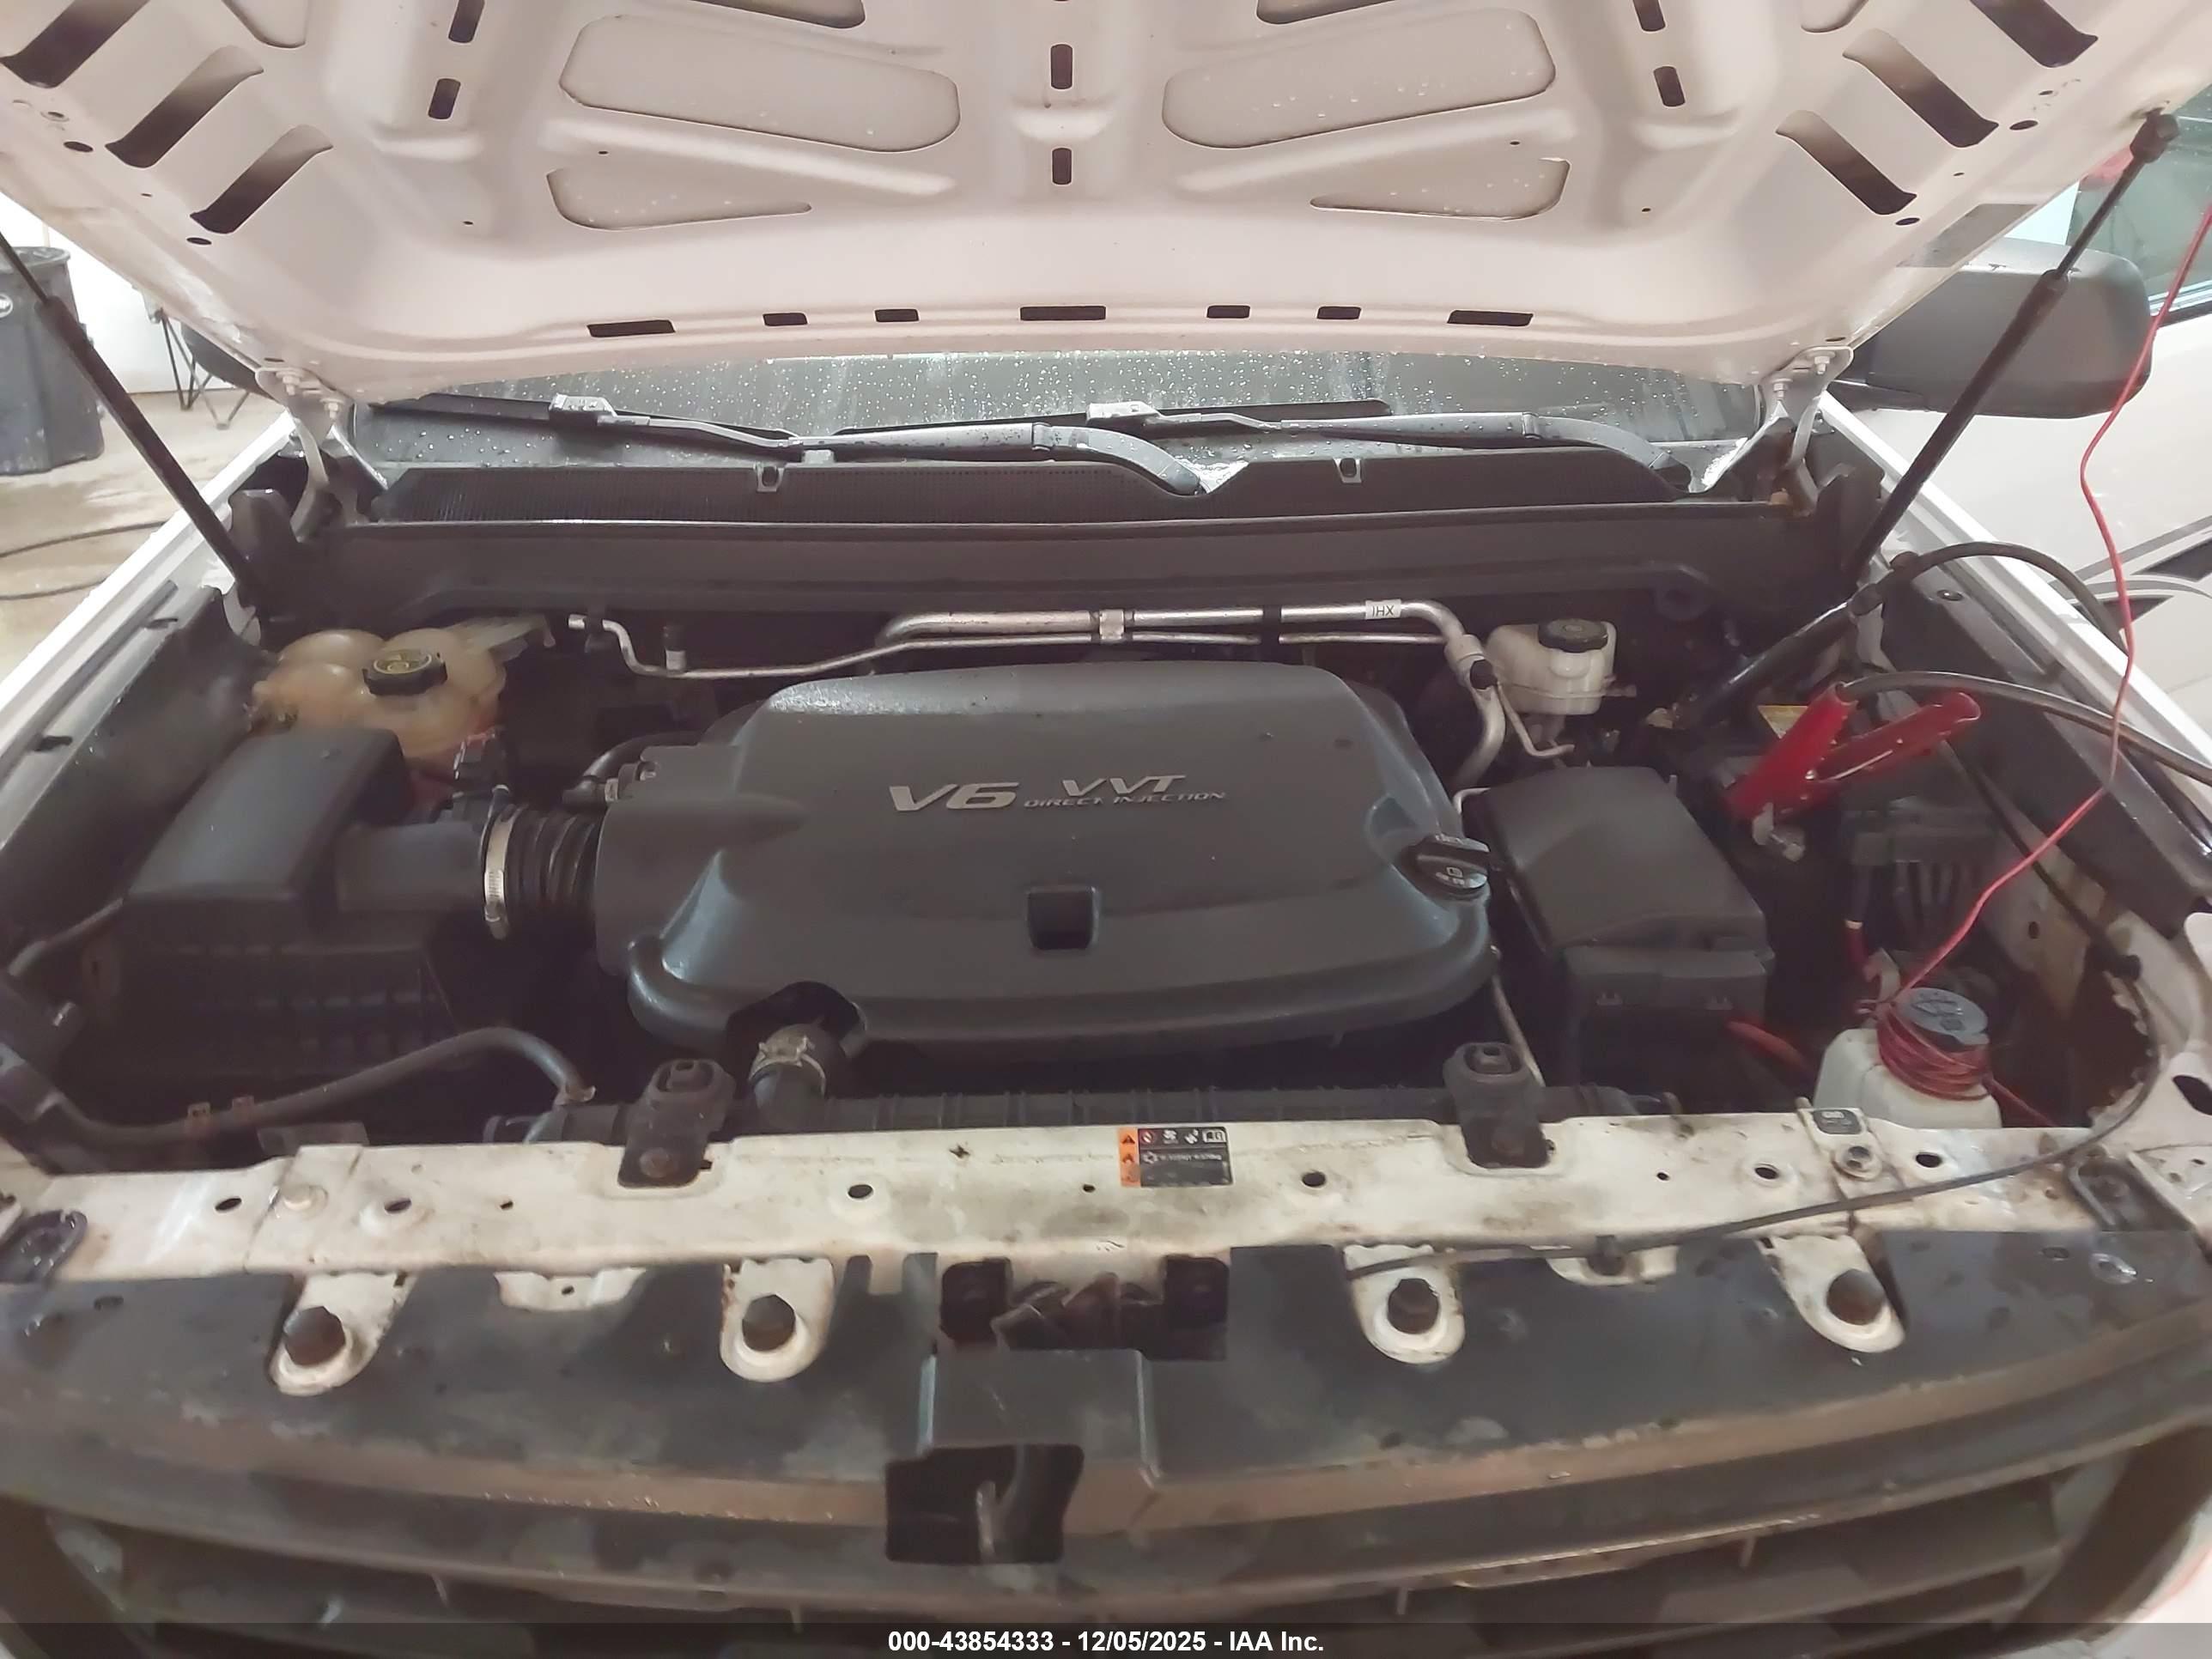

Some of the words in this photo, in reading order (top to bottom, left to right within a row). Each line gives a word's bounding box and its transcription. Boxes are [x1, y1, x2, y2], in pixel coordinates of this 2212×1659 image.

[1372, 605, 1395, 617] IHX
[1062, 775, 1187, 797] VVT
[889, 781, 1020, 811] V6
[1024, 796, 1104, 808] DIRECT
[1113, 792, 1226, 805] INJECTION
